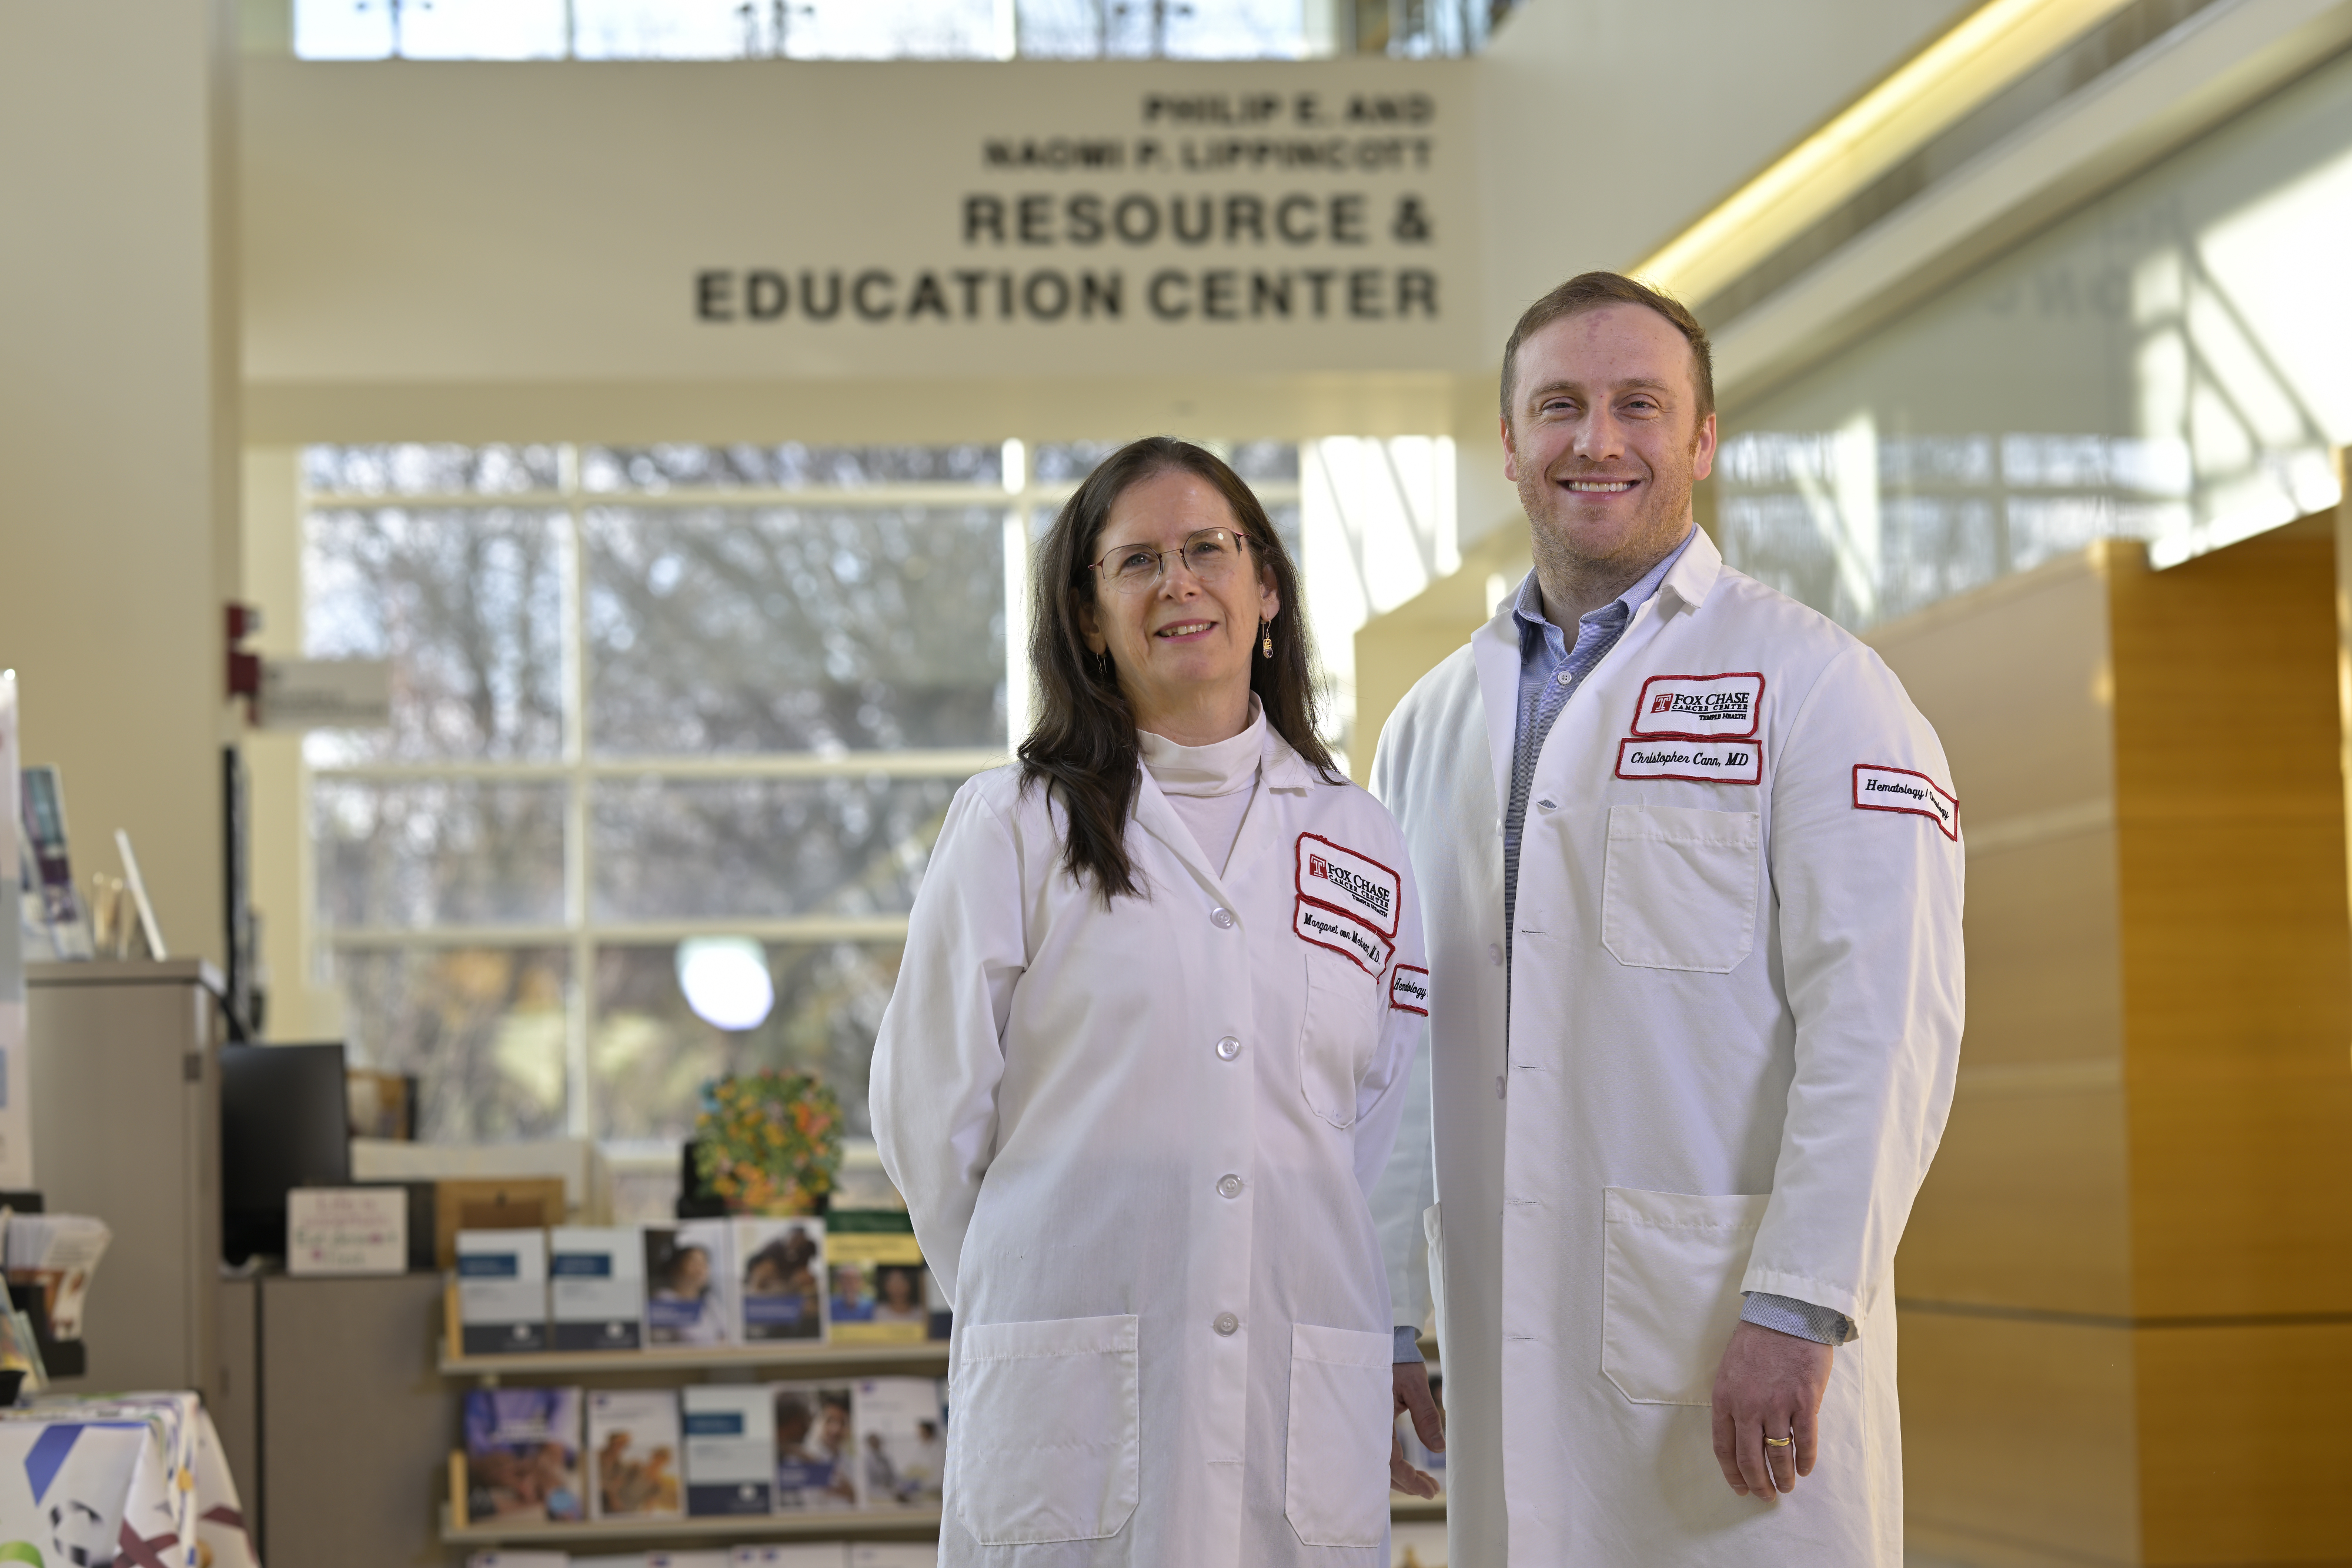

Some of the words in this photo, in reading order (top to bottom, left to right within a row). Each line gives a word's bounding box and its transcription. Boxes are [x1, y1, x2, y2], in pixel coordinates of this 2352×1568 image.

[1143, 93, 1282, 126] PHILIP
[1295, 93, 1334, 126] E.
[1344, 93, 1434, 126] AND
[984, 139, 1124, 169] NAOMI
[1135, 139, 1173, 170] P.
[1182, 138, 1432, 170] LIPPINCOTT
[963, 195, 1365, 245] RESOURCE
[1392, 195, 1432, 244] &
[696, 269, 1124, 322] EDUCATION
[1147, 269, 1438, 321] CENTER
[1673, 694, 1704, 706] FOX
[1705, 693, 1750, 706] CHASE
[1631, 751, 1690, 766] Christopher
[1693, 753, 1721, 767] Cann,
[1725, 753, 1749, 766] MD
[1865, 779, 1924, 800] Hematology
[1328, 862, 1352, 883] FOX
[1353, 874, 1390, 902] CHASE
[1328, 874, 1358, 892] CANCER
[1361, 890, 1388, 908] CENTER
[1352, 893, 1371, 907] TEMPLE
[1371, 904, 1388, 918] HEALTH
[1304, 912, 1338, 934] Margaret
